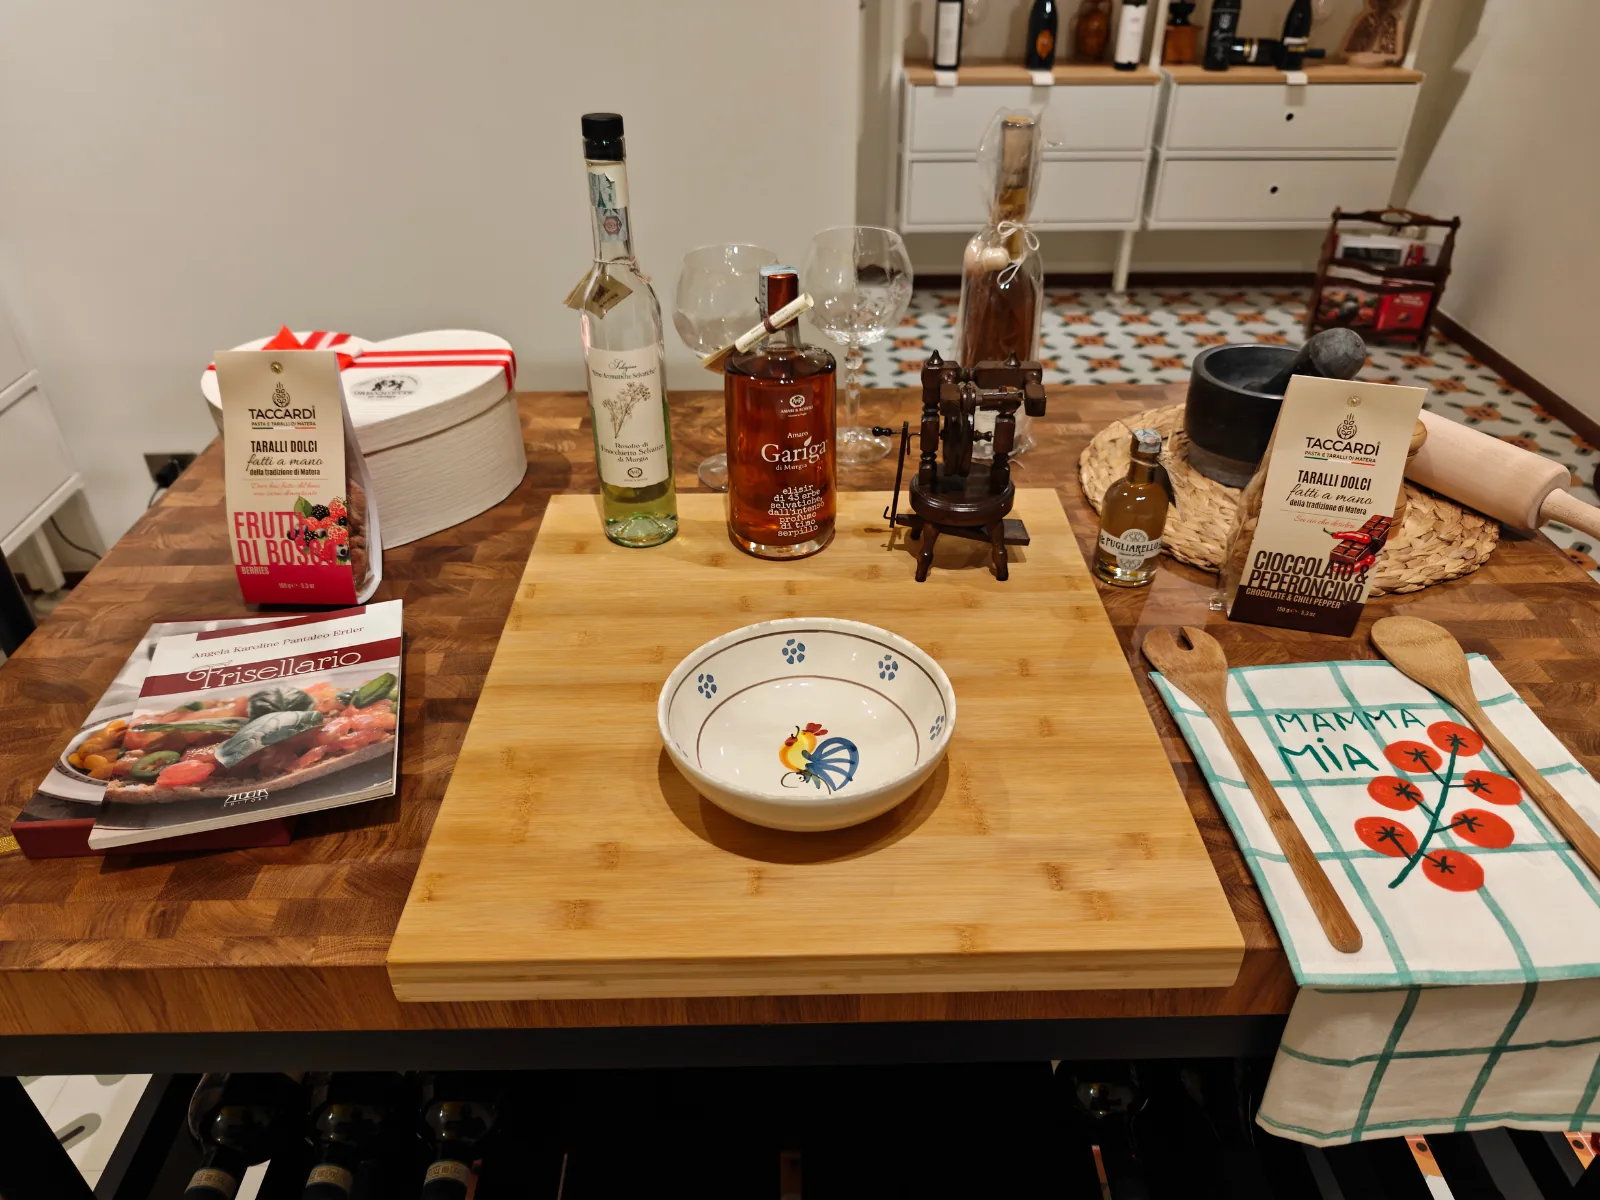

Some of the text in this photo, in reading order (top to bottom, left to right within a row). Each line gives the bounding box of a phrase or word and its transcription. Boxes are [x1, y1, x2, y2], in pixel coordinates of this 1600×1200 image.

[787, 431, 809, 439] Amaro
[250, 440, 318, 453] TARALLI DOLCI
[761, 436, 827, 464] Gariga
[245, 454, 323, 472] fatti a mano
[1326, 452, 1348, 460] TARALLI
[294, 468, 299, 476] di
[784, 463, 808, 471] Murgia
[1298, 470, 1372, 491] TARALLI DOLCI
[773, 494, 785, 502] di
[801, 489, 820, 499] erbe
[782, 485, 814, 494] elisir
[1286, 483, 1373, 505] fatti a mano
[768, 501, 824, 516] dall'intenso
[771, 496, 823, 509] selvatiche,
[1289, 499, 1367, 515] della tradizione di Matera
[233, 511, 304, 539] FRUTTI
[779, 511, 817, 524] profumo
[781, 518, 816, 530] di timo
[777, 525, 819, 537] serpillo
[237, 538, 337, 566] DI BOSCO
[1105, 537, 1159, 554] PUGLIARELLO
[241, 566, 270, 575] BERRIES
[1253, 550, 1370, 584] CIOCCOLATO &
[1247, 569, 1364, 602] PEPERONCINO
[1245, 587, 1285, 600] CHOCOLATE
[1293, 594, 1313, 605] CHILI
[1313, 598, 1341, 609] PEPPER
[192, 626, 365, 659] Angela Karoline Pantaleo Ertler
[1275, 708, 1426, 733] MAMMA
